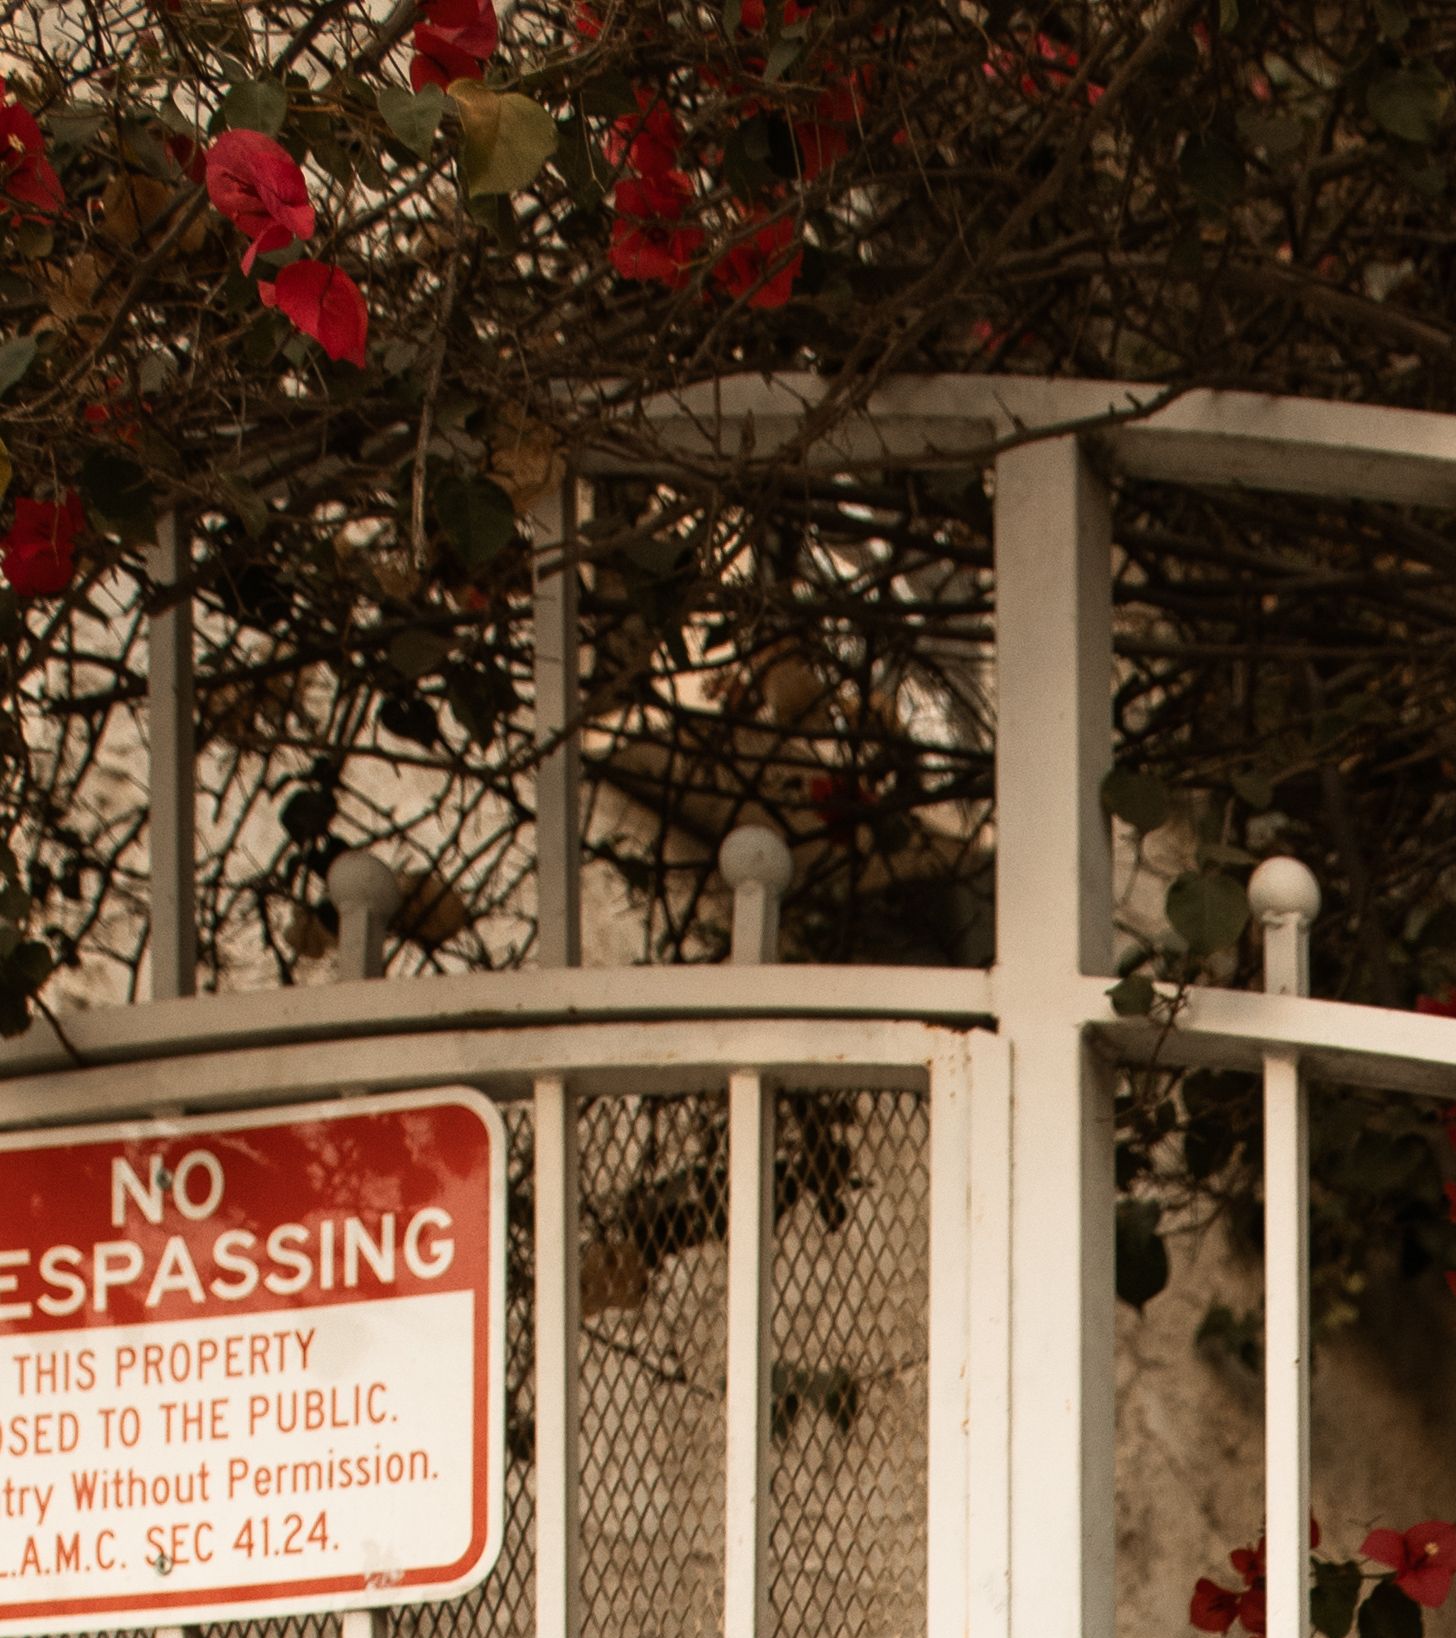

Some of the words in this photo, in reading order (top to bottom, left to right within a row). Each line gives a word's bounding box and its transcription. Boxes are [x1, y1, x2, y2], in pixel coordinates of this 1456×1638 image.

[111, 1149, 225, 1227] NO
[13, 1349, 96, 1396] THIS
[115, 1327, 316, 1388] PROPERTY
[0, 1410, 79, 1457] SED
[98, 1406, 140, 1449] TO
[160, 1397, 229, 1445] THE
[248, 1382, 398, 1439] PUBLIC.
[71, 1459, 210, 1512] Without
[229, 1445, 439, 1500] Permission.
[146, 1522, 214, 1568] SEC
[233, 1511, 340, 1560] 41.24.
